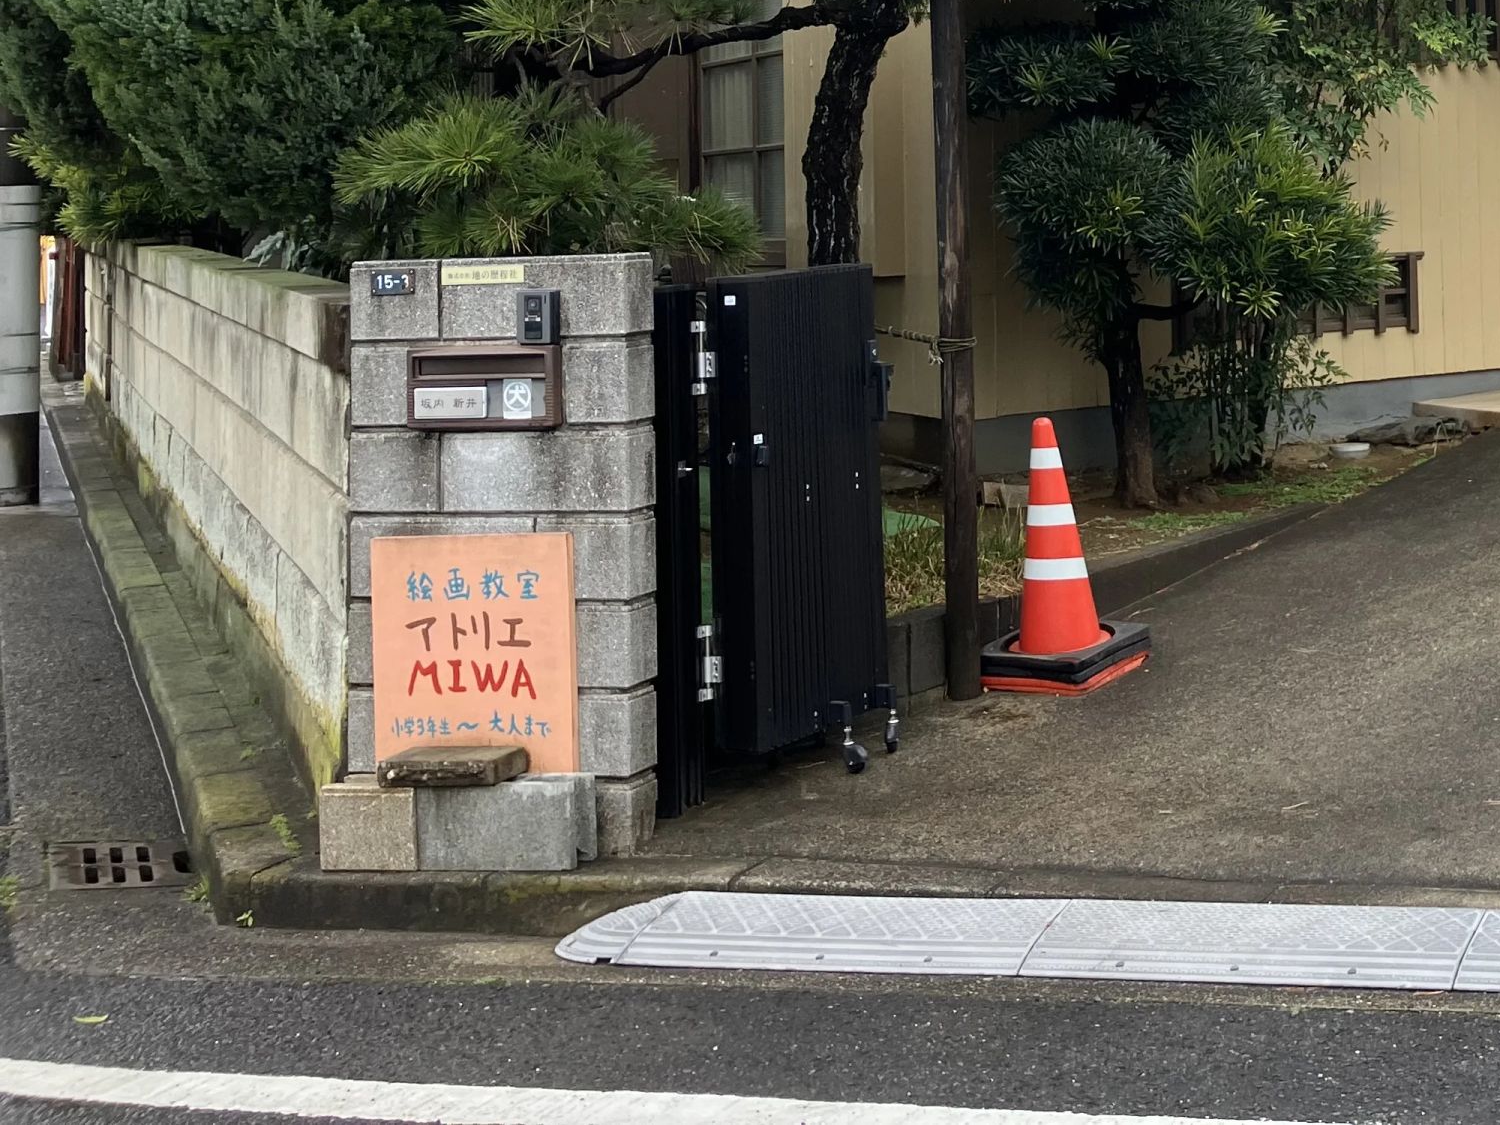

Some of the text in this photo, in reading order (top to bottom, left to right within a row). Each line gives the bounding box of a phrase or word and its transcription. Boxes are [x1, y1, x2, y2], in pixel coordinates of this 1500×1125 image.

[406, 567, 541, 602] 絵画教室
[404, 610, 532, 651] アトリエ
[407, 658, 537, 700] MIWA
